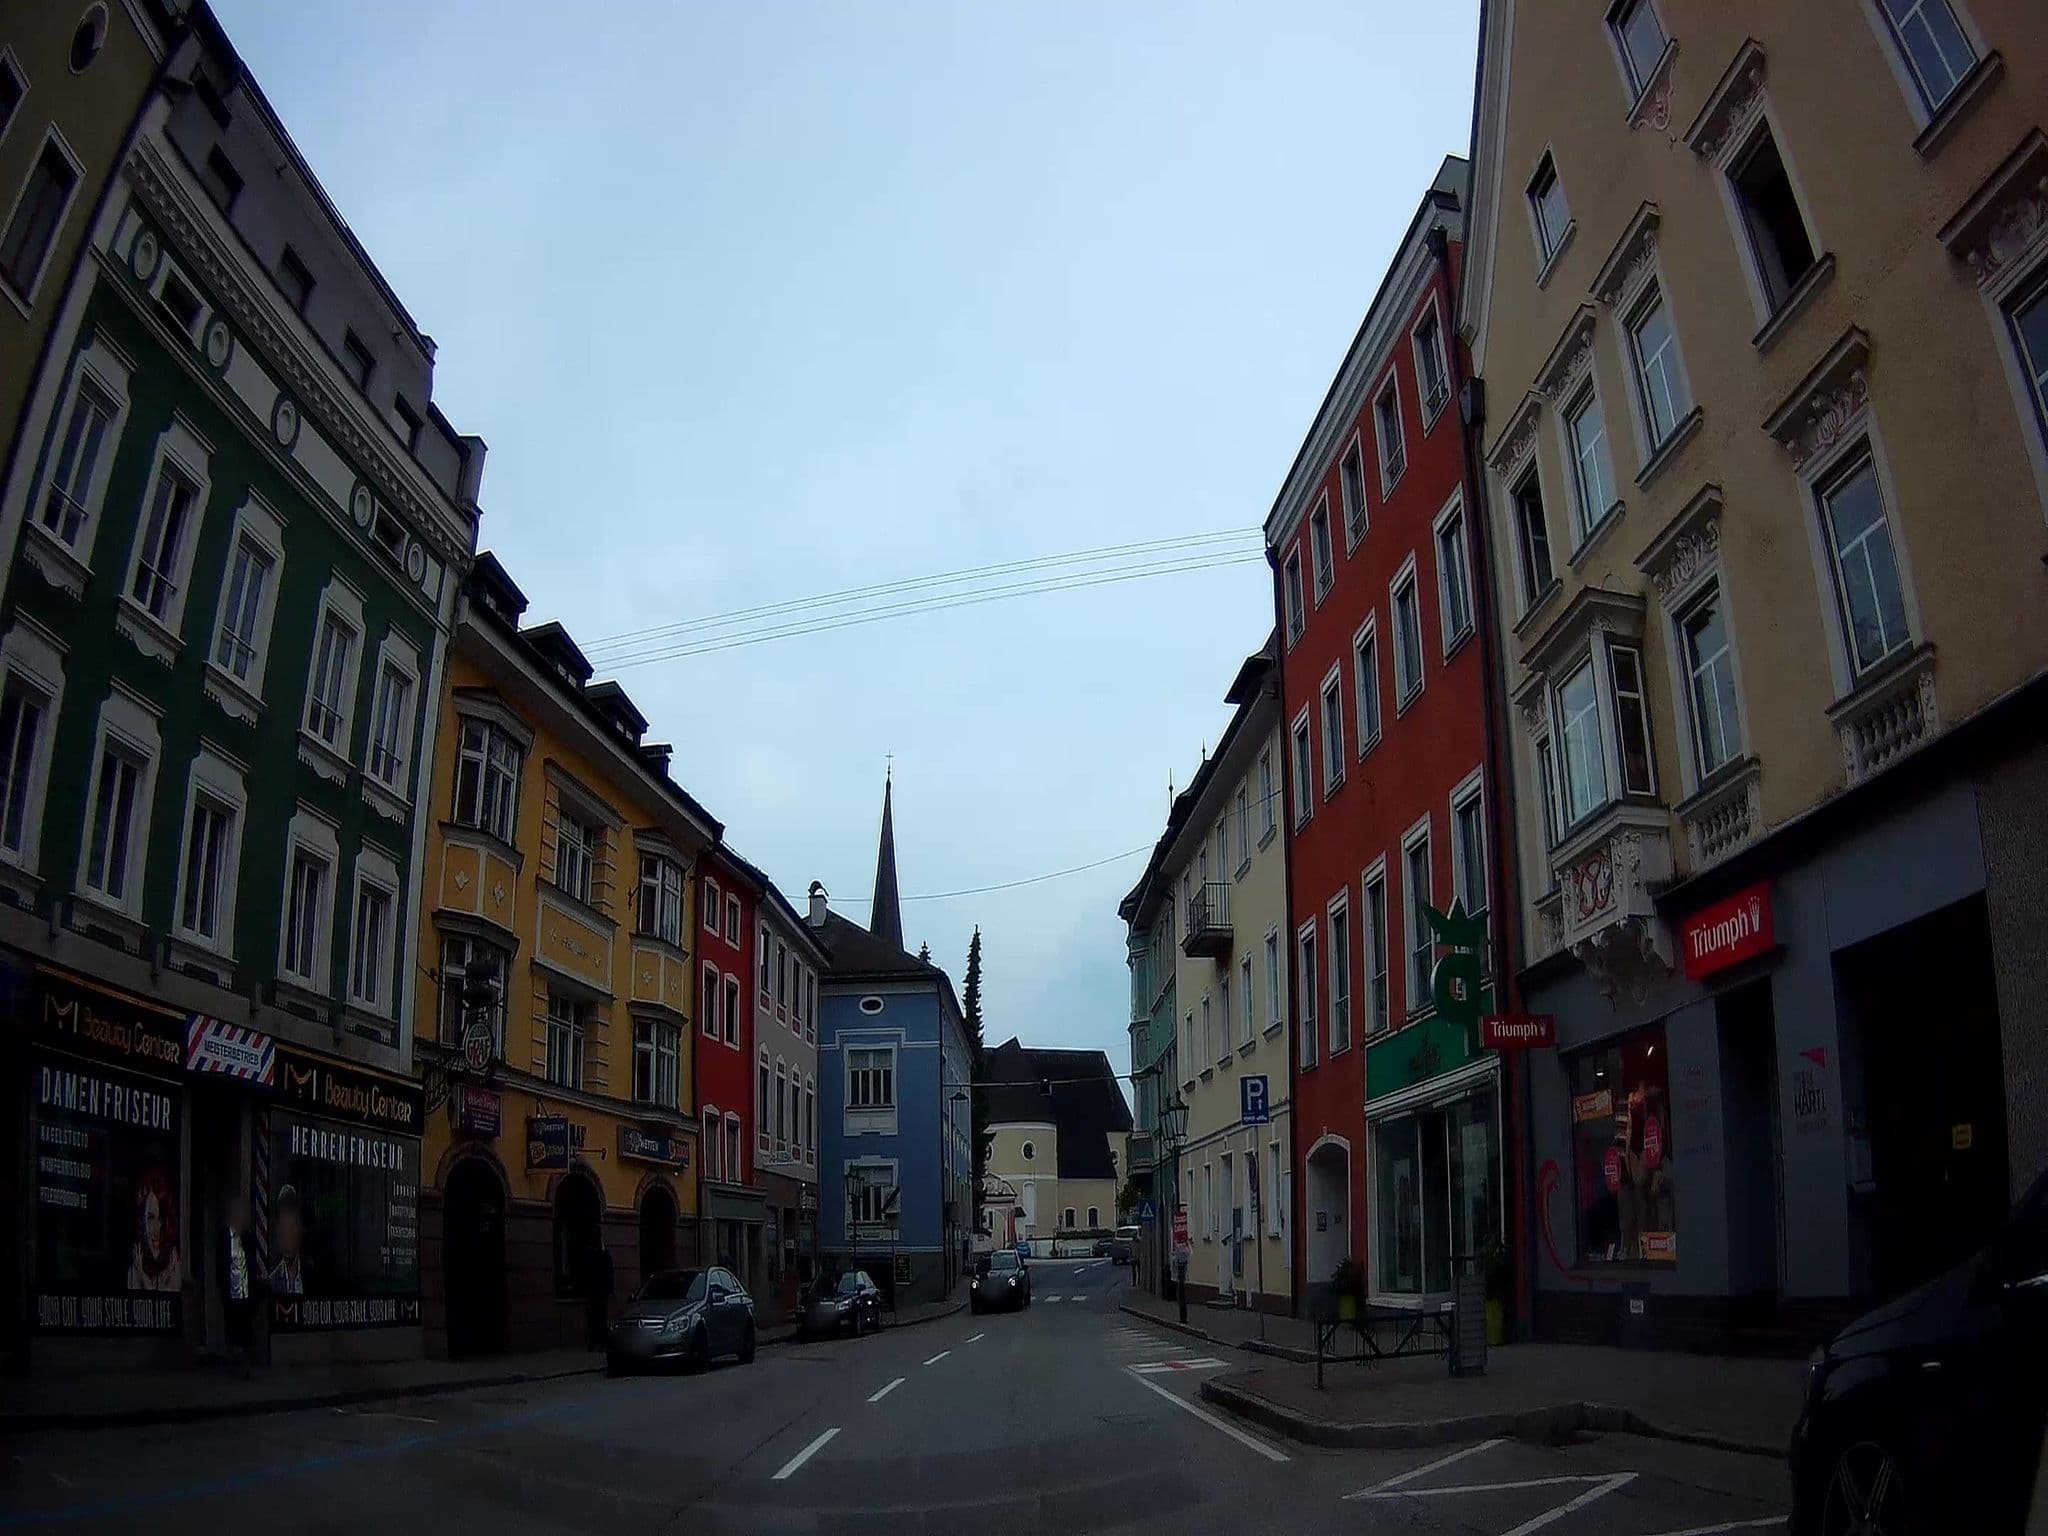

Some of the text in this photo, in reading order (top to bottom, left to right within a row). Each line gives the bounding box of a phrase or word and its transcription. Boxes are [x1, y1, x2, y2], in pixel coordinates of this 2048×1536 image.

[1689, 907, 1749, 959] Triumph
[1490, 1021, 1538, 1041] Triumph
[324, 1072, 370, 1120] Beauty
[1246, 1079, 1264, 1111] P
